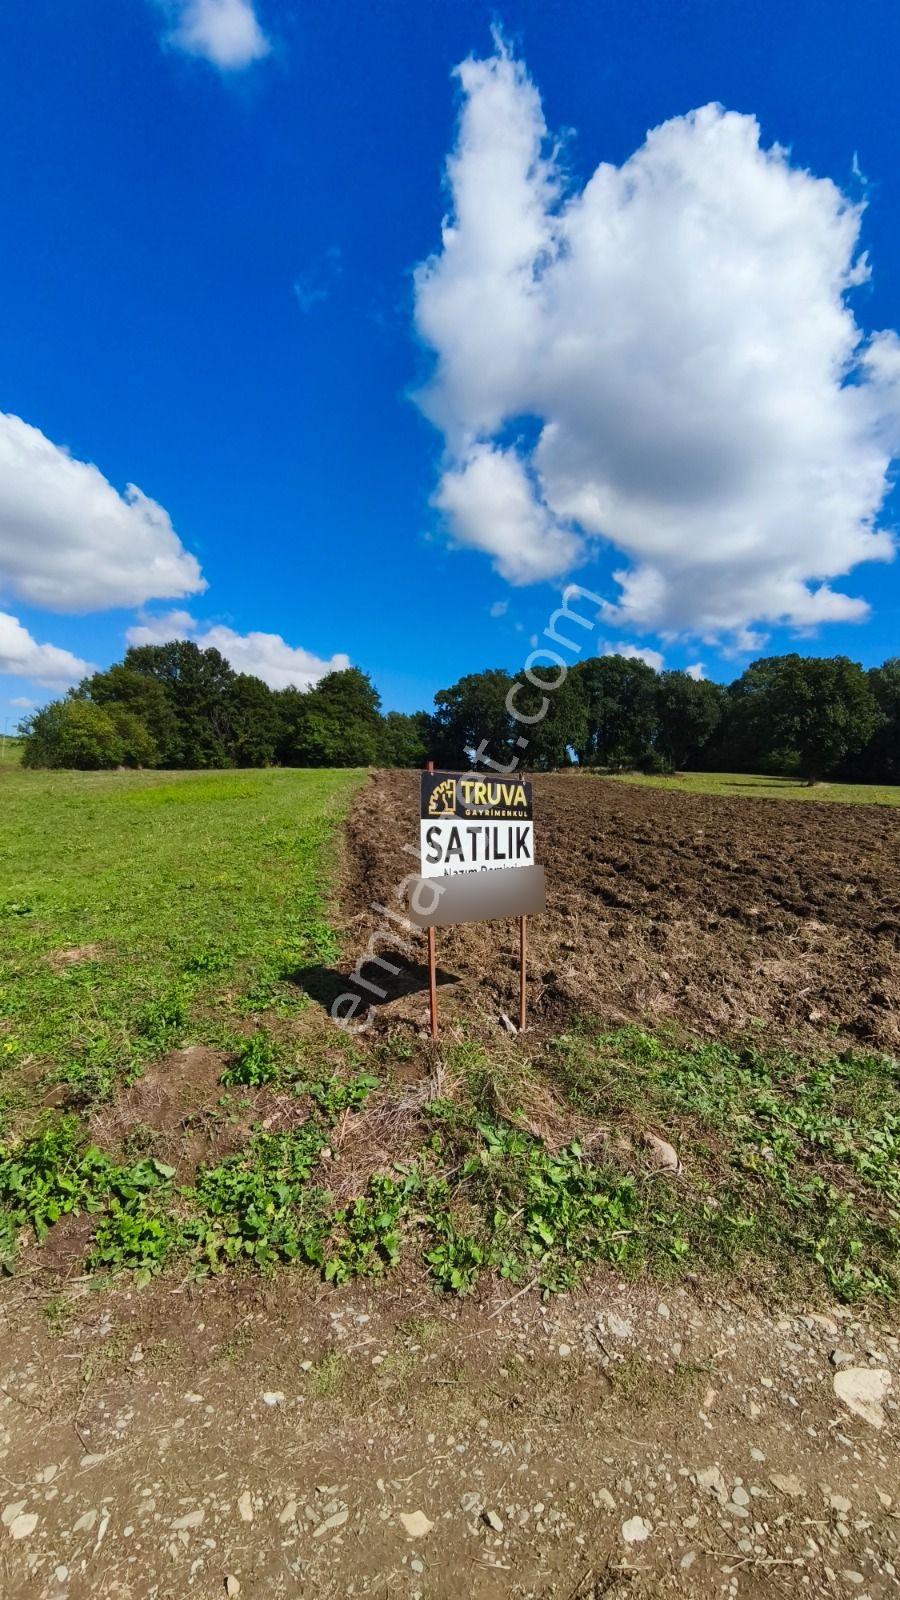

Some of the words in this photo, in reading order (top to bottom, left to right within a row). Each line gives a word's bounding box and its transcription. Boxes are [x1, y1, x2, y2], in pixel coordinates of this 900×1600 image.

[461, 781, 528, 807] TRUVA
[465, 808, 528, 818] GAYRİMENKUL
[425, 825, 531, 864] SATILIK
